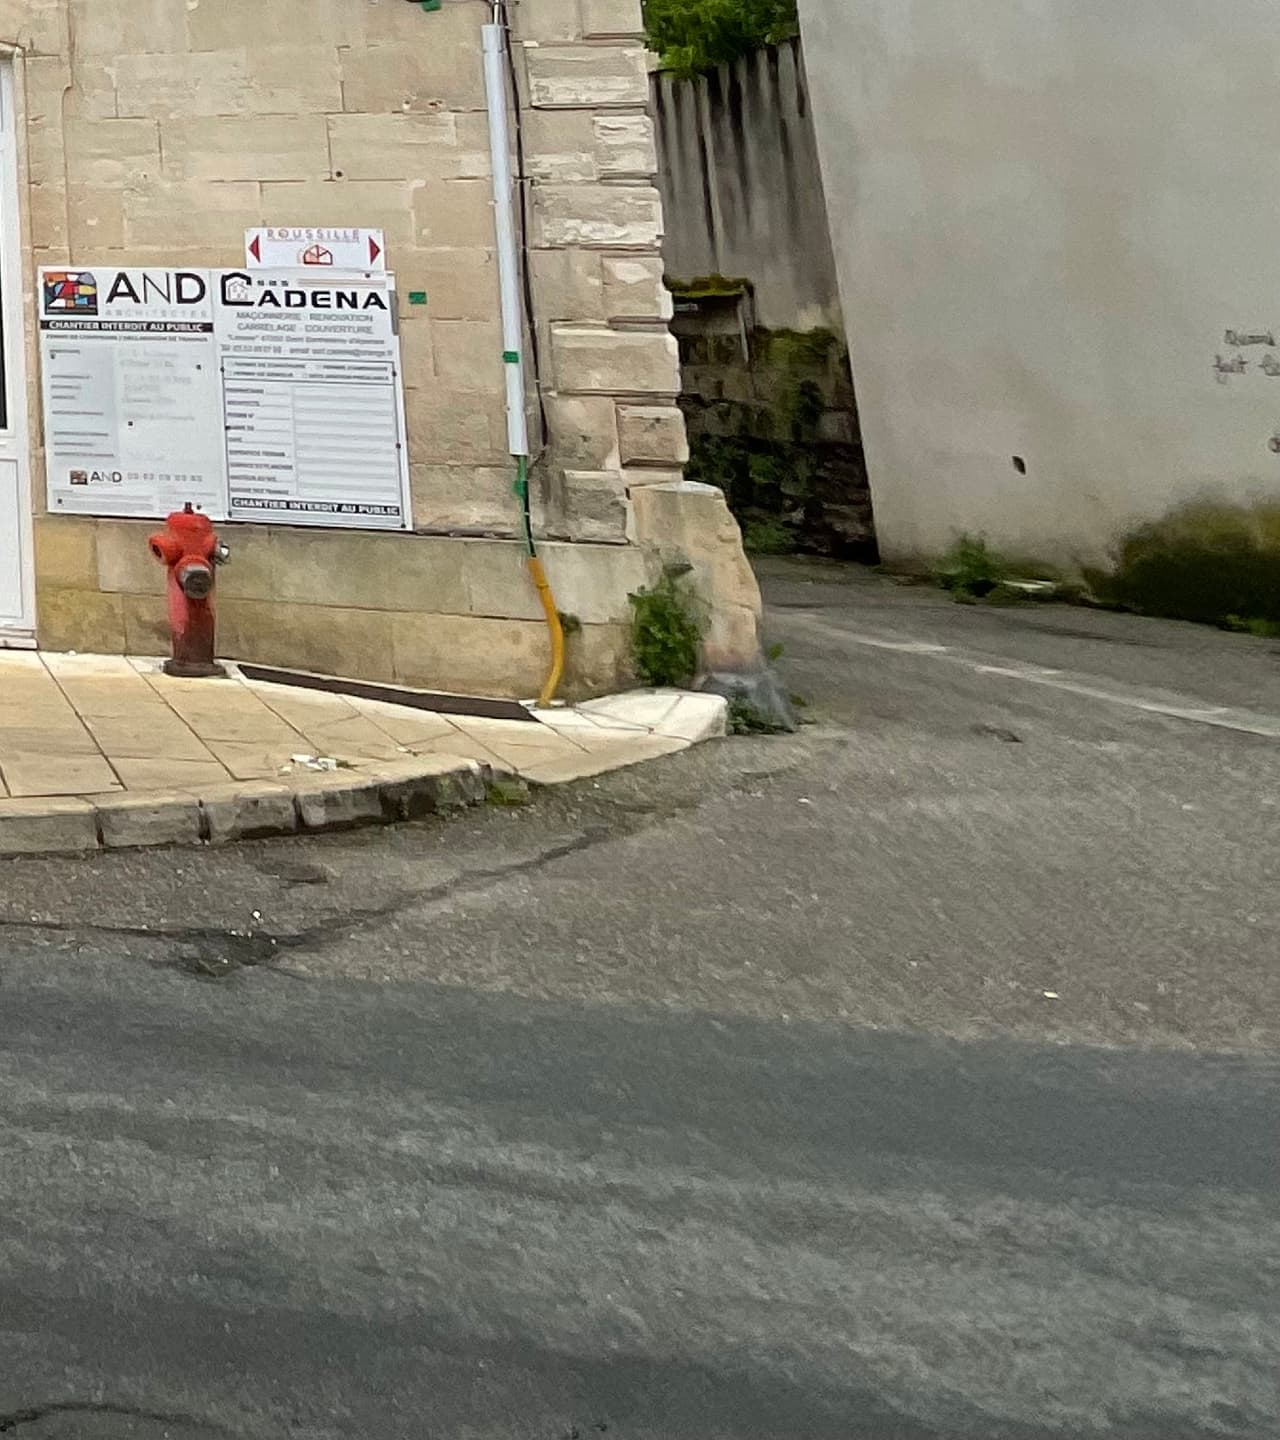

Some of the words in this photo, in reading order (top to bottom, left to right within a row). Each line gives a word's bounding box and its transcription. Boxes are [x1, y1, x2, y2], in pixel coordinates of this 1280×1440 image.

[267, 229, 360, 240] ROUSSILLE
[106, 272, 206, 304] AND
[221, 272, 388, 310] CADENA
[48, 320, 99, 330] CHANTIER
[101, 321, 147, 331] INTERDIT
[149, 323, 165, 331] AU
[166, 323, 203, 332] PUBLIC
[237, 323, 297, 333] CARRELAGE
[304, 324, 375, 335] COUVERTURE
[90, 471, 122, 483] AND
[232, 498, 287, 509] CHANTIER
[289, 501, 339, 512] INTERDIT
[341, 504, 357, 513] AU
[358, 505, 399, 516] PUBLIC
